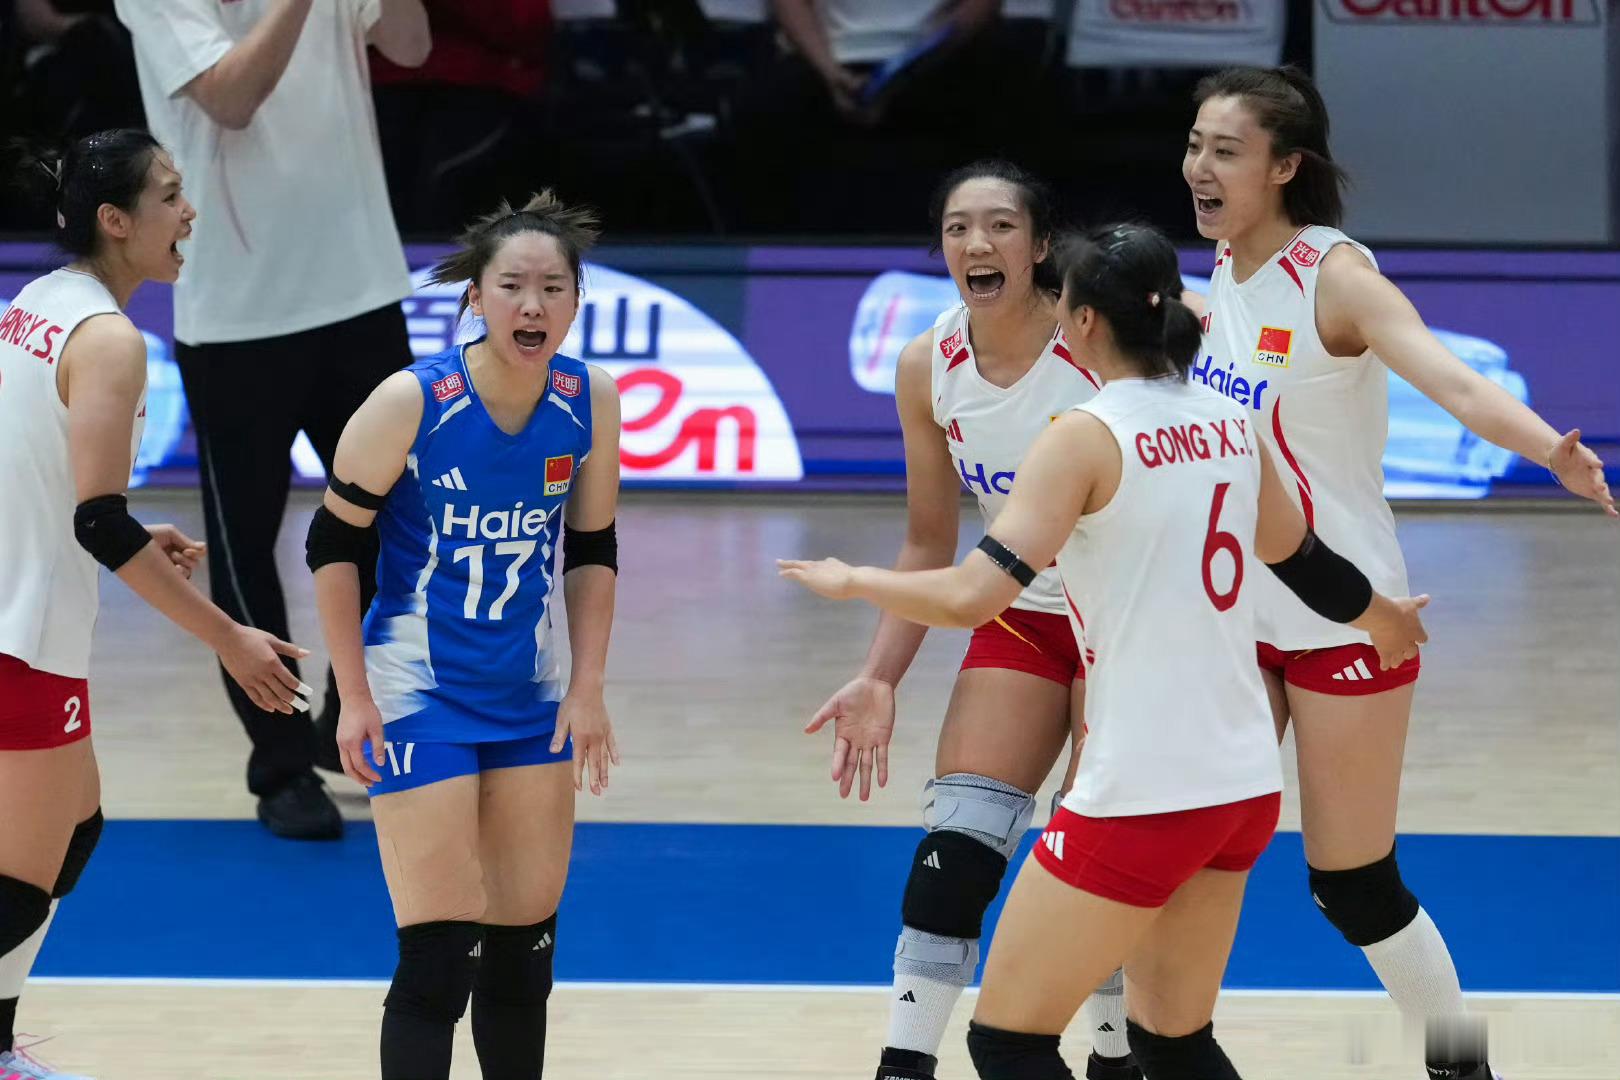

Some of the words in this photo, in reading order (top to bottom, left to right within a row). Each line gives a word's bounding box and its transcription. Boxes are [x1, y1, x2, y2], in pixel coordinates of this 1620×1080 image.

[1257, 352, 1284, 364] CHN
[433, 375, 462, 397] 光明
[554, 373, 578, 391] 光明
[1192, 354, 1267, 410] Haier
[1135, 423, 1211, 469] GONG
[548, 483, 569, 493] CHN
[442, 501, 548, 540] Haie
[1201, 482, 1243, 612] 6
[453, 540, 537, 621] 17
[64, 695, 81, 734] 2
[384, 741, 416, 776] 17
